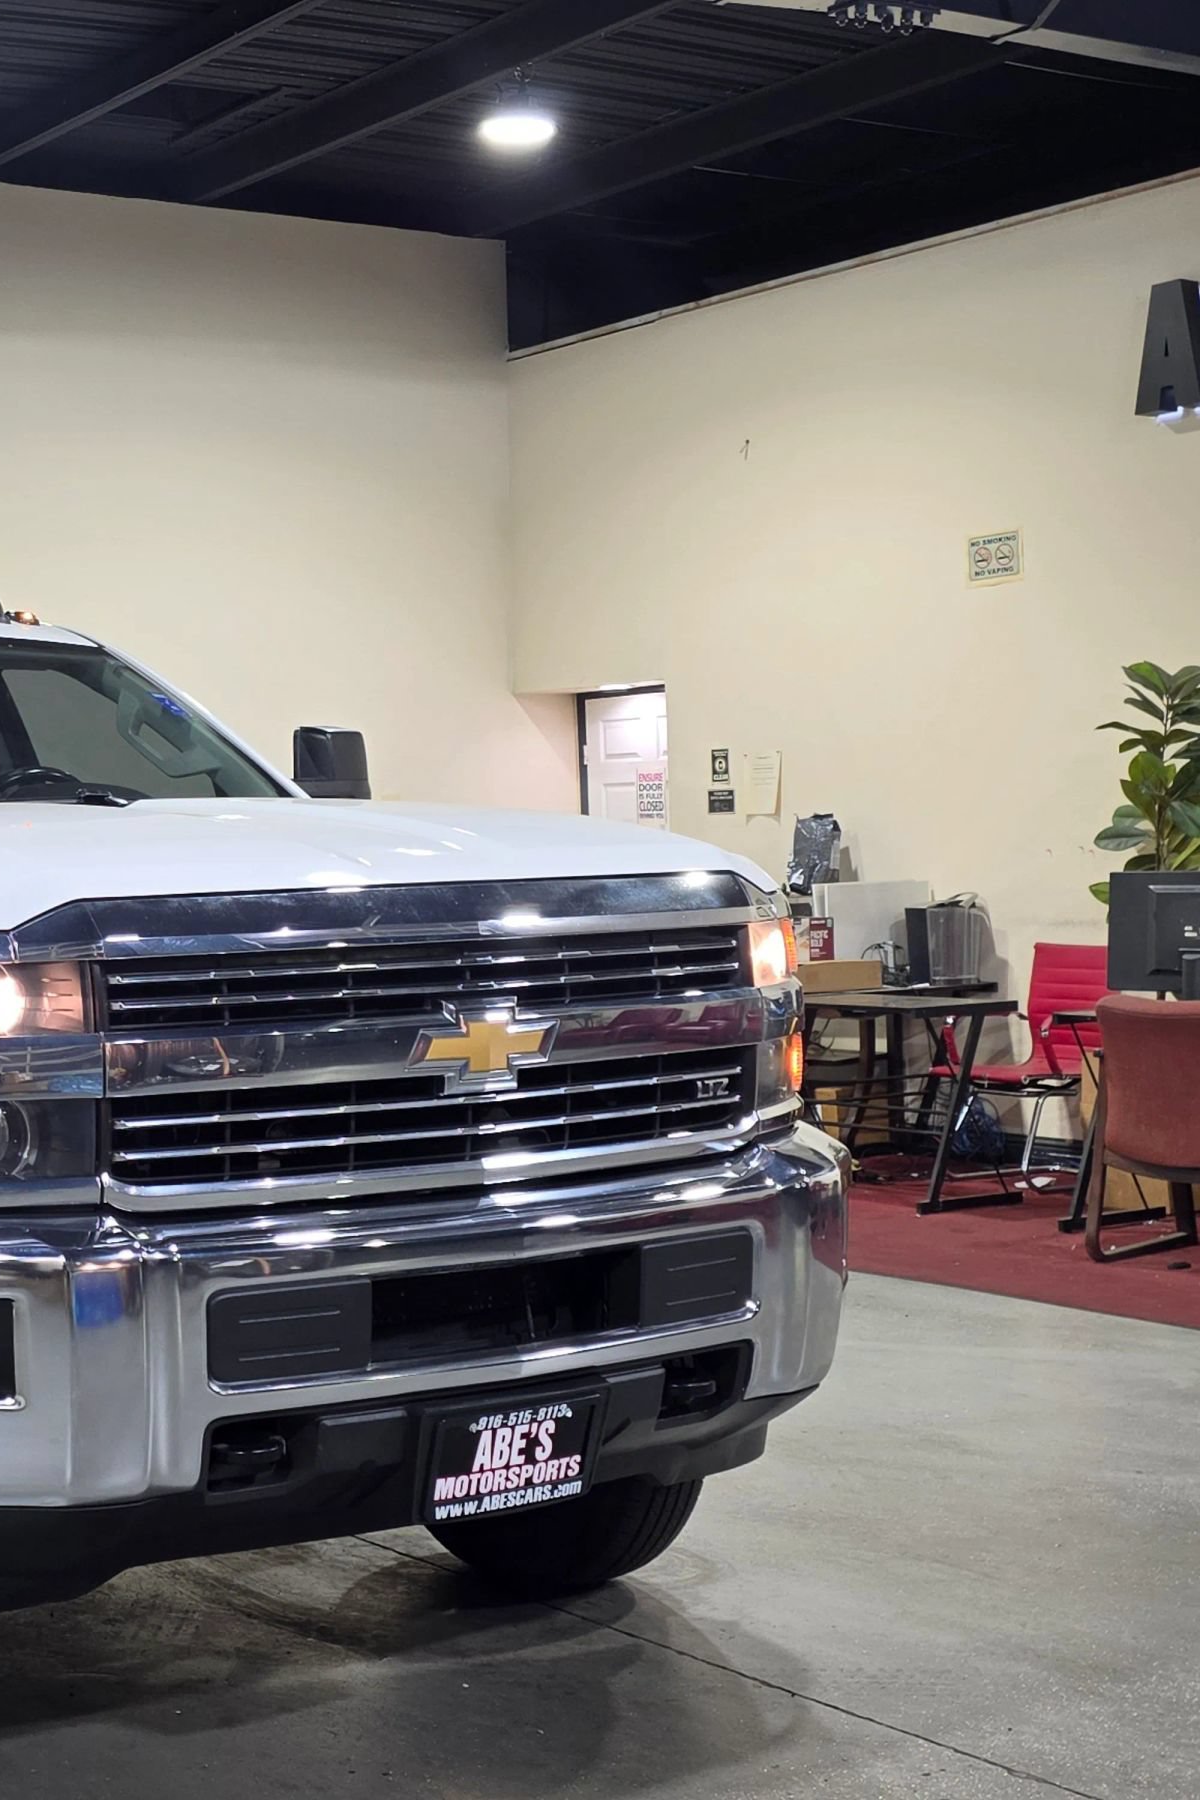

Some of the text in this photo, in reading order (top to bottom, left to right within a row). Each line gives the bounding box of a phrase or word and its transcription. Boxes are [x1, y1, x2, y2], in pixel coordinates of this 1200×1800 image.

[982, 534, 1017, 546] SMOKING
[987, 566, 1014, 575] VAPING
[639, 773, 663, 782] ENSURE
[639, 783, 663, 791] DOOR
[639, 801, 664, 811] CLOSED
[696, 1077, 729, 1098] LTZ
[471, 1419, 556, 1473] ABE'S
[433, 1454, 582, 1501] MOTORSPORTS
